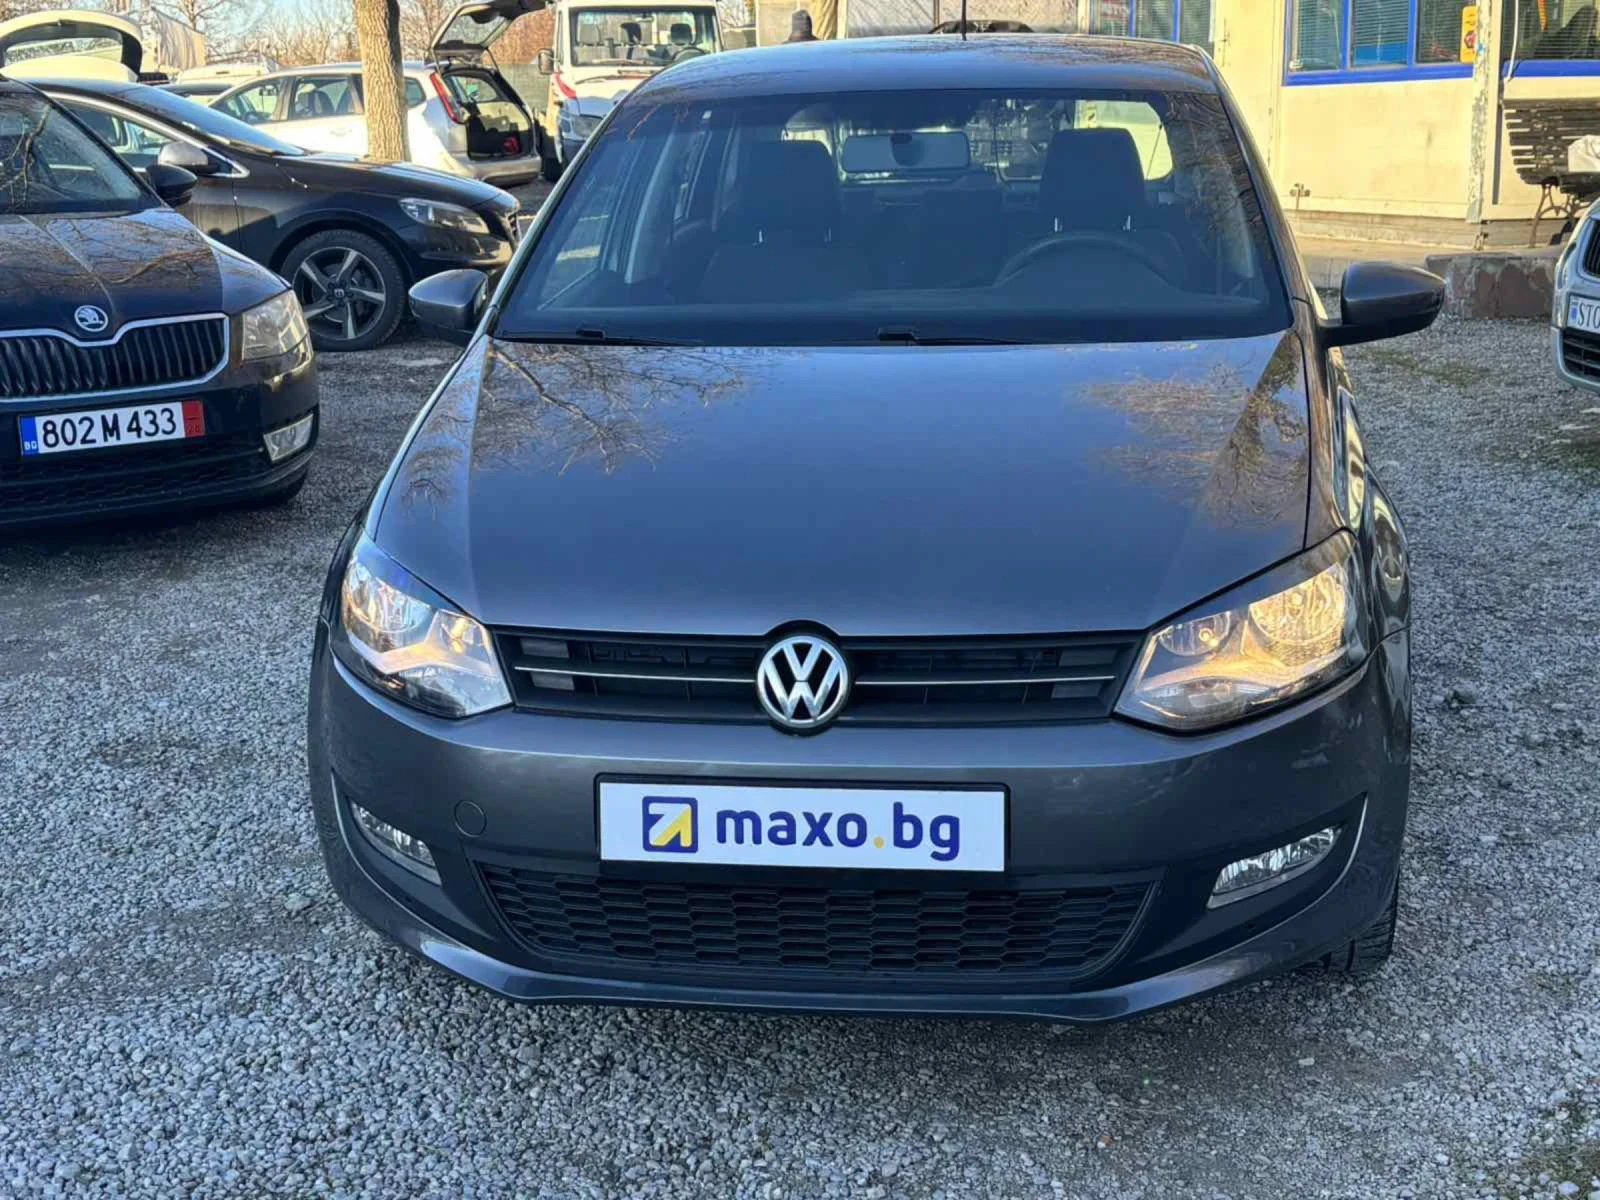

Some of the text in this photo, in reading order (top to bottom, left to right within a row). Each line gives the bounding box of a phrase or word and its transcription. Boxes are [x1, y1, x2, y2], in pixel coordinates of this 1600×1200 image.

[42, 416, 97, 448] 802
[101, 412, 121, 442] M
[126, 407, 176, 438] 433
[716, 802, 960, 862] maxo.bg
